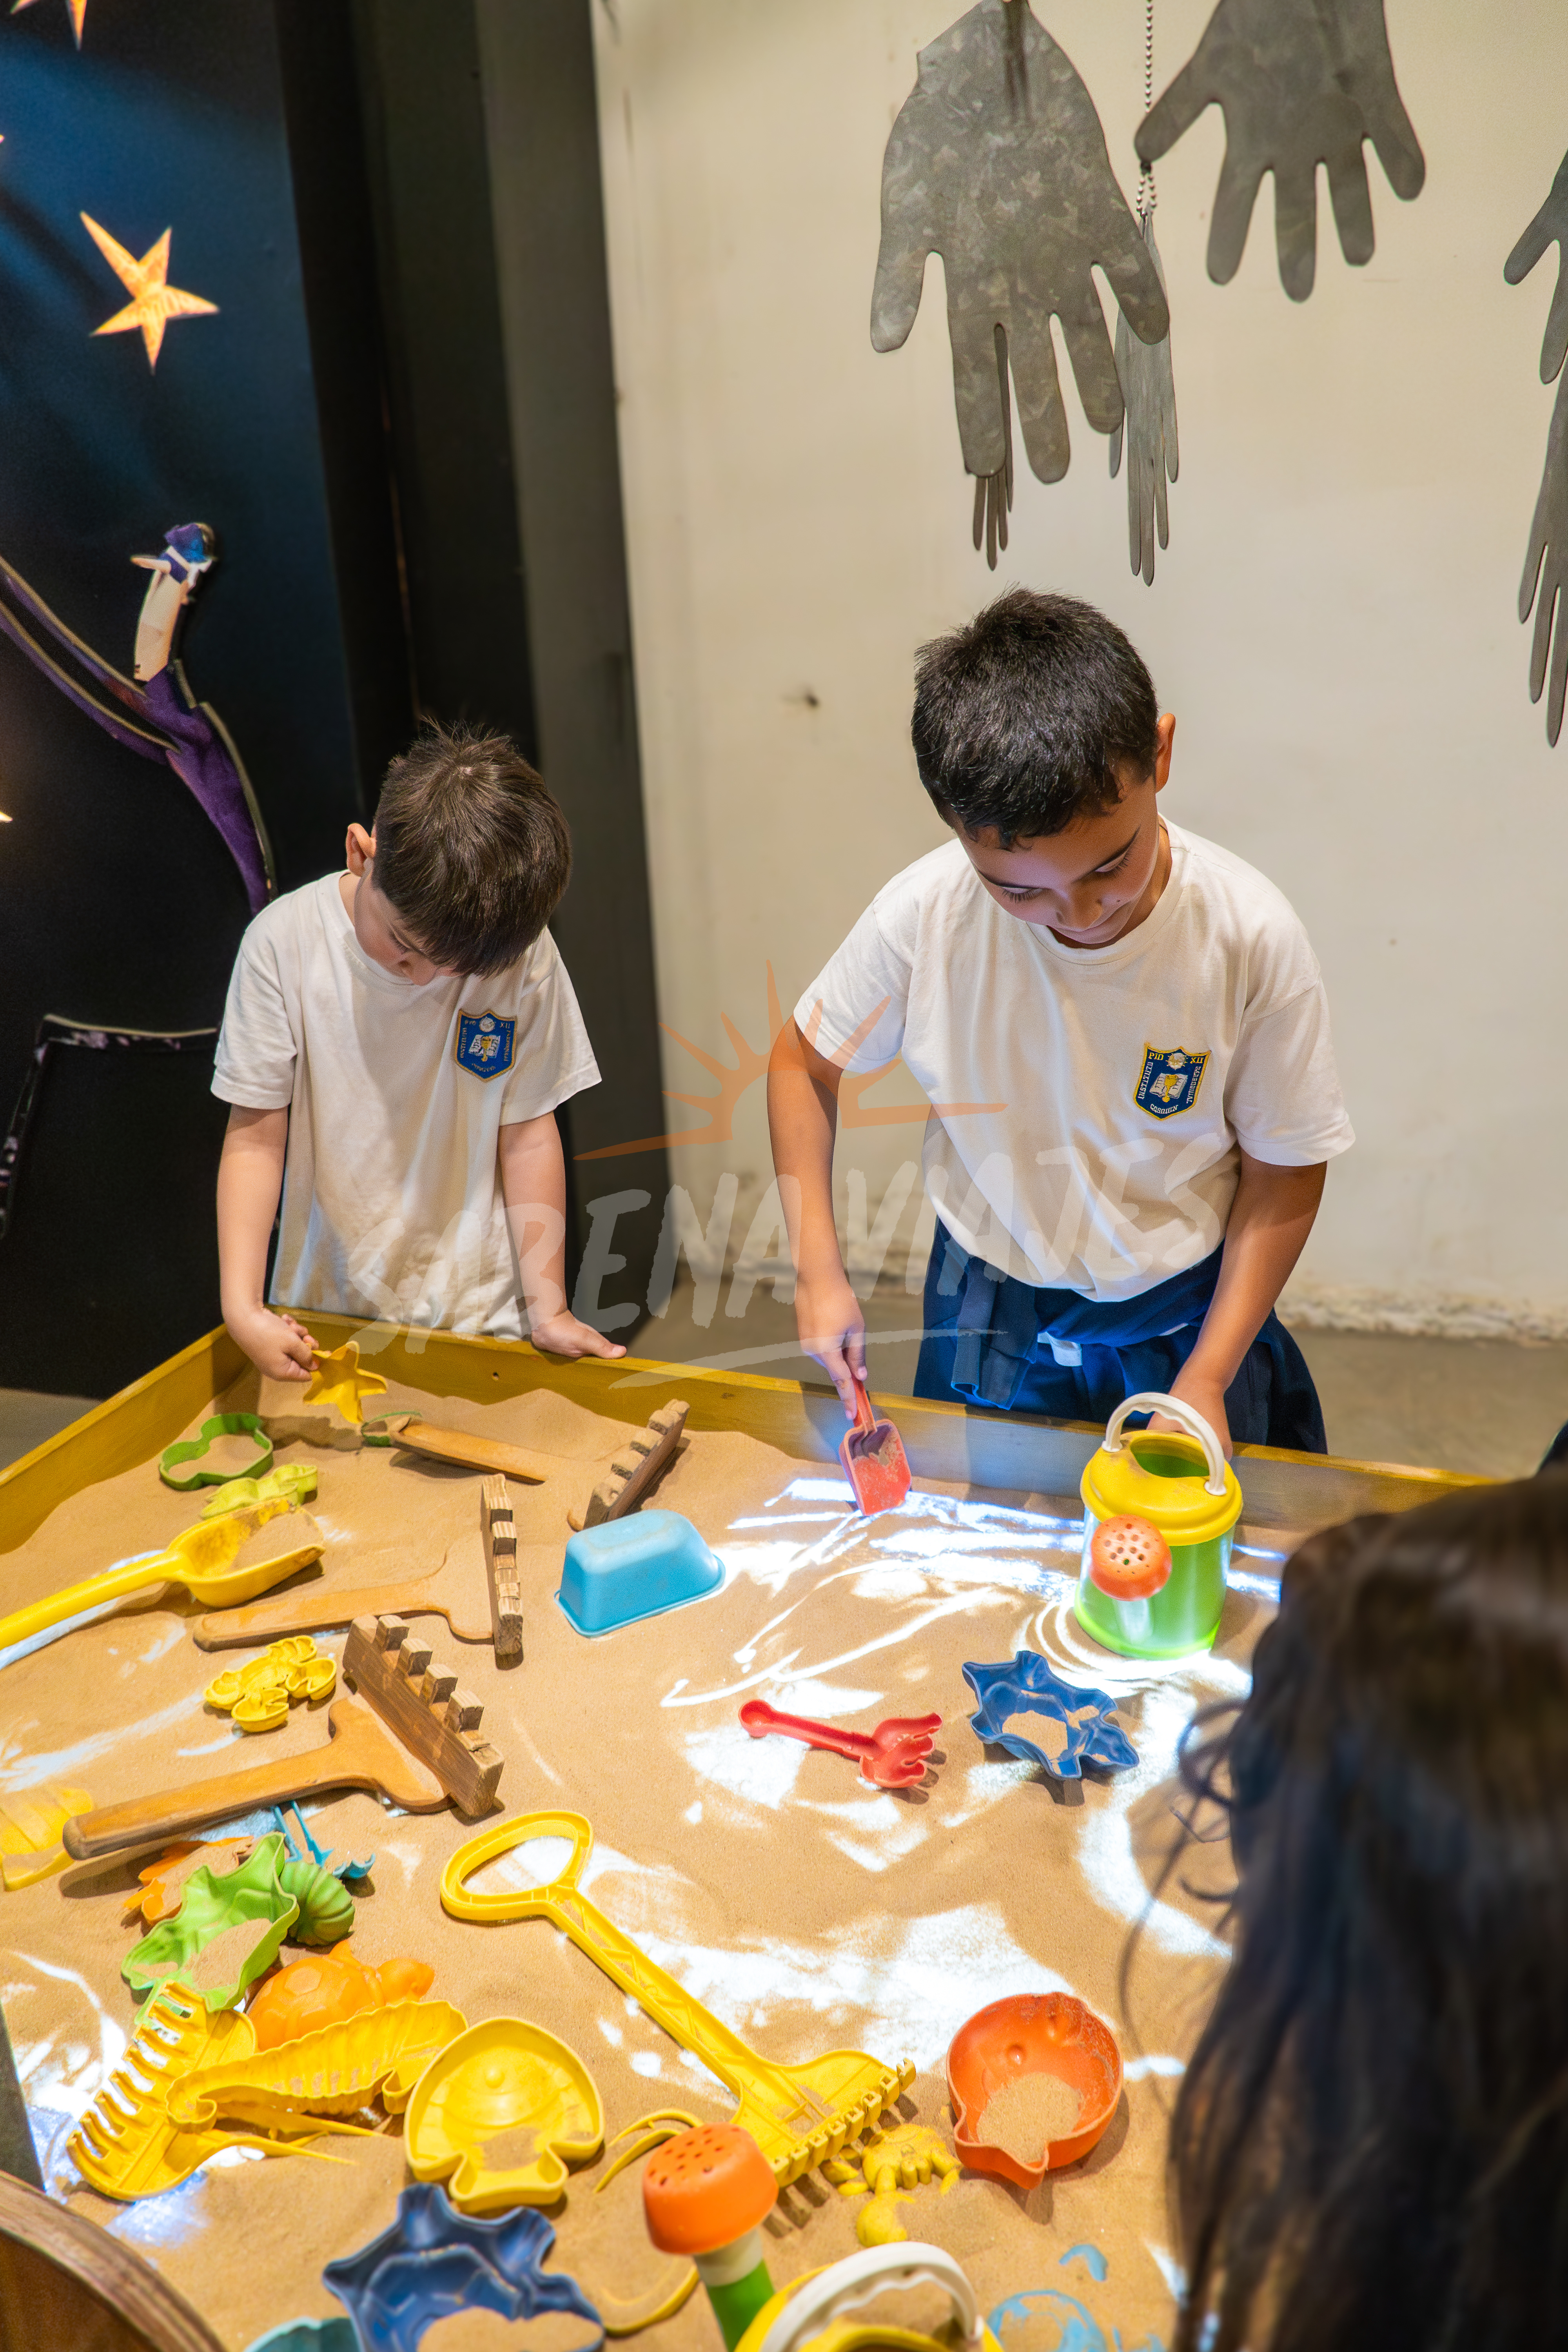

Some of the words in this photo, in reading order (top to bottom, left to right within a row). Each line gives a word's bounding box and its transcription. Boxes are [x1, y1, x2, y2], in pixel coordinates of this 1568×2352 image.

[1148, 1052, 1164, 1060] PIO
[1138, 1062, 1153, 1100] INSTITUTO
[1150, 1103, 1179, 1114] COSQUIN
